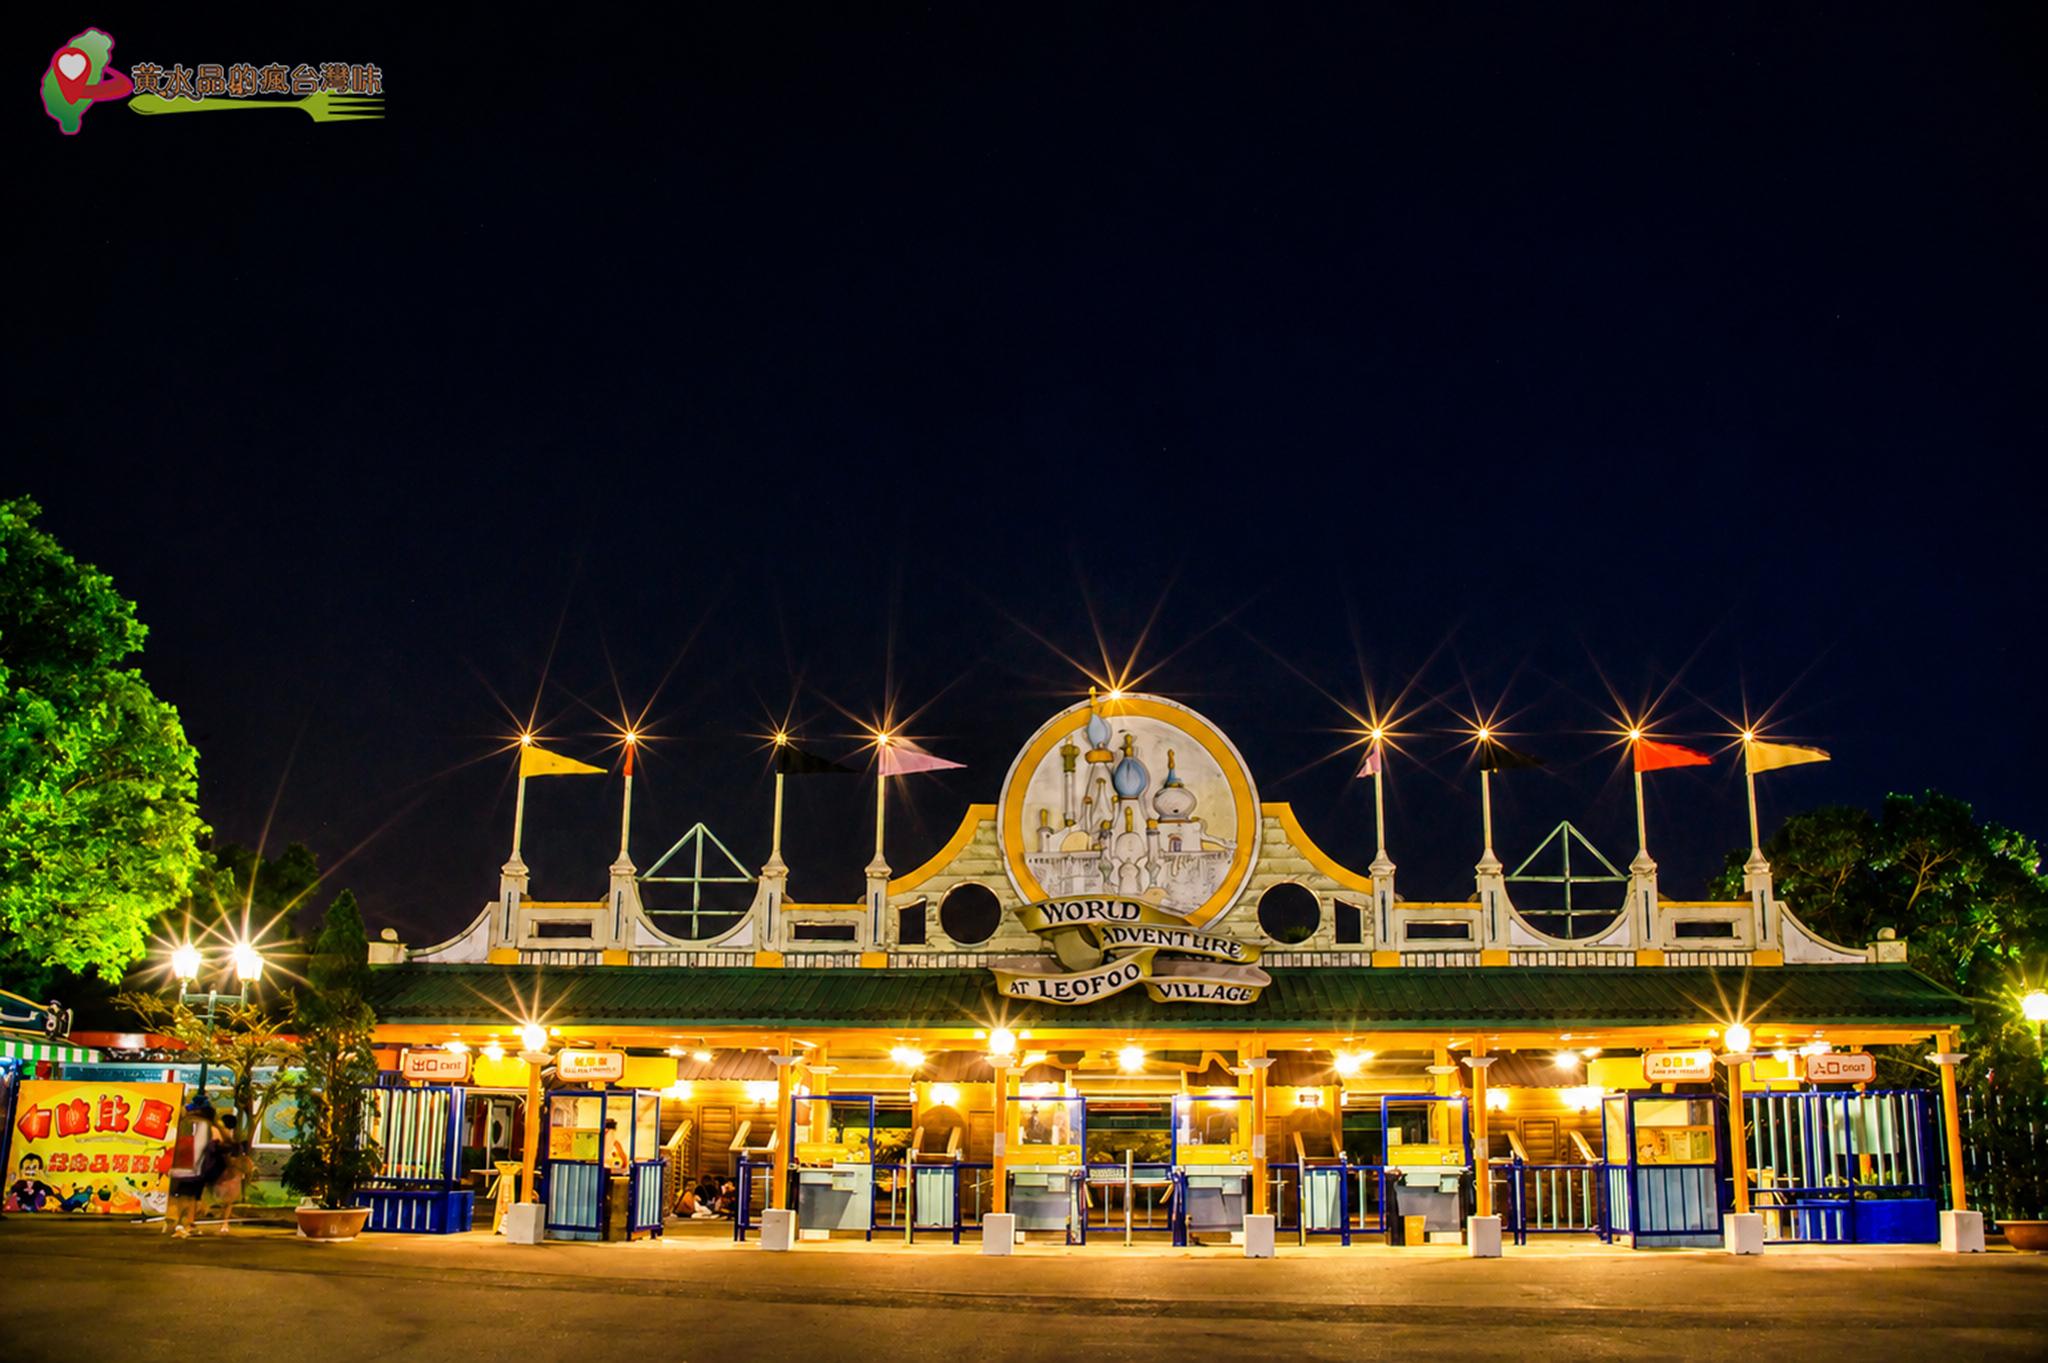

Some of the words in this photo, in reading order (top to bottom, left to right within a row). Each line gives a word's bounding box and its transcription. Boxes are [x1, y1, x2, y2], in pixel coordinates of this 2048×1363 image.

[1038, 900, 1141, 924] WORLD
[1102, 926, 1242, 958] ADVENTURE
[1009, 981, 1030, 996] AT
[1039, 963, 1141, 1002] LEOFOO
[1156, 983, 1252, 1001] VILLAGE
